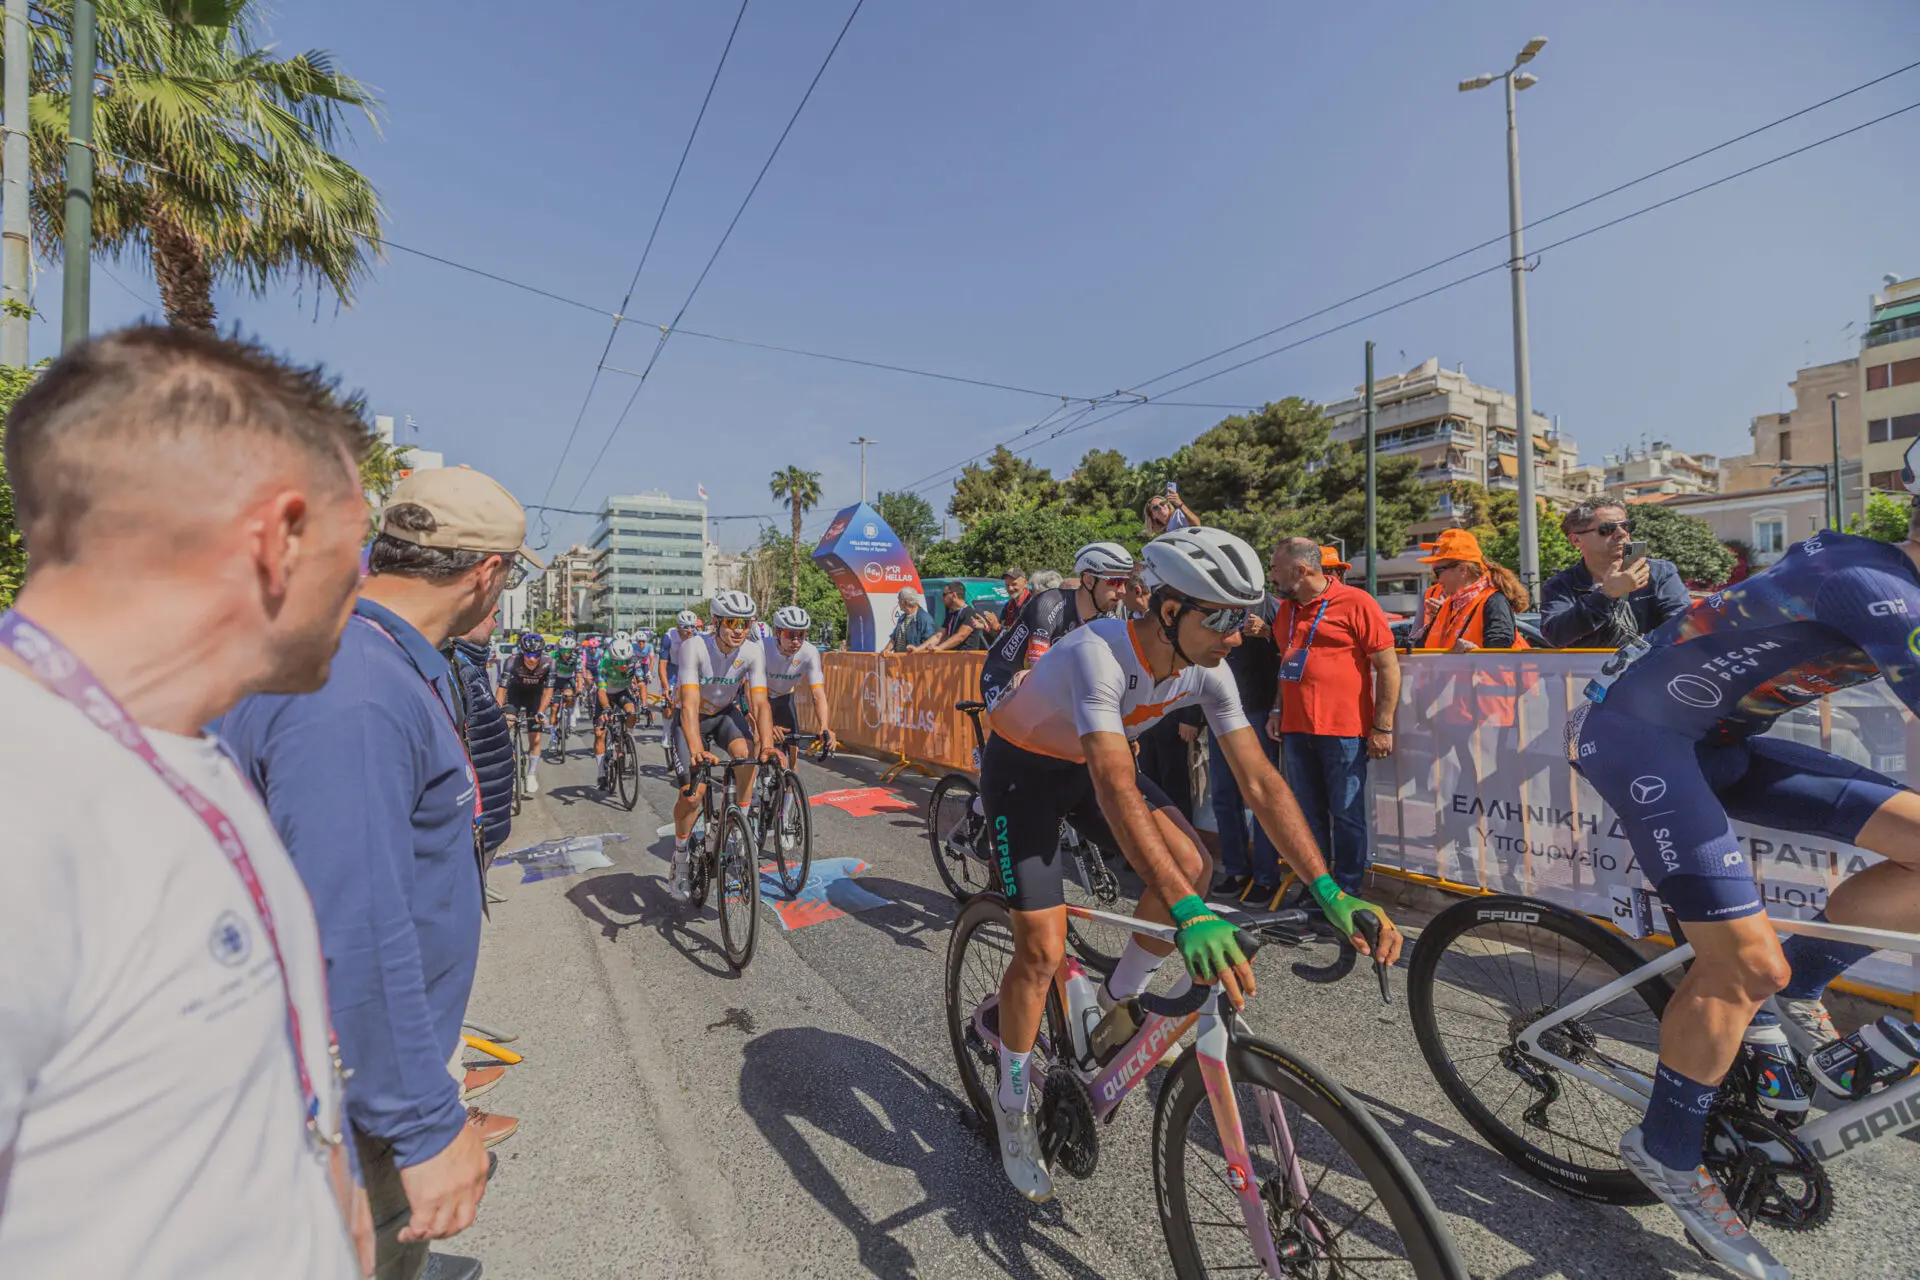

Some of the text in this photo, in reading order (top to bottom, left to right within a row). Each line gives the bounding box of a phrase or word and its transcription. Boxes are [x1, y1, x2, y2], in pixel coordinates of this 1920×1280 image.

[886, 574, 913, 582] HELLAS
[1003, 626, 1027, 659] KASPER
[1701, 641, 1782, 672] TECAM
[1719, 657, 1759, 681] PCV
[889, 704, 935, 732] HELLAS
[1452, 794, 1598, 835] ΕΛΛΗΝΙΚΗ
[995, 815, 1017, 897] CYPRUS
[1476, 826, 1618, 871] Υπουργείο
[1653, 828, 1681, 872] SAGA
[1181, 914, 1219, 930] CYPRUS
[1477, 910, 1540, 923] FFWD
[1612, 896, 1634, 918] 75
[1010, 1058, 1024, 1095] CYPRUS
[1103, 1042, 1152, 1101] QUICK
